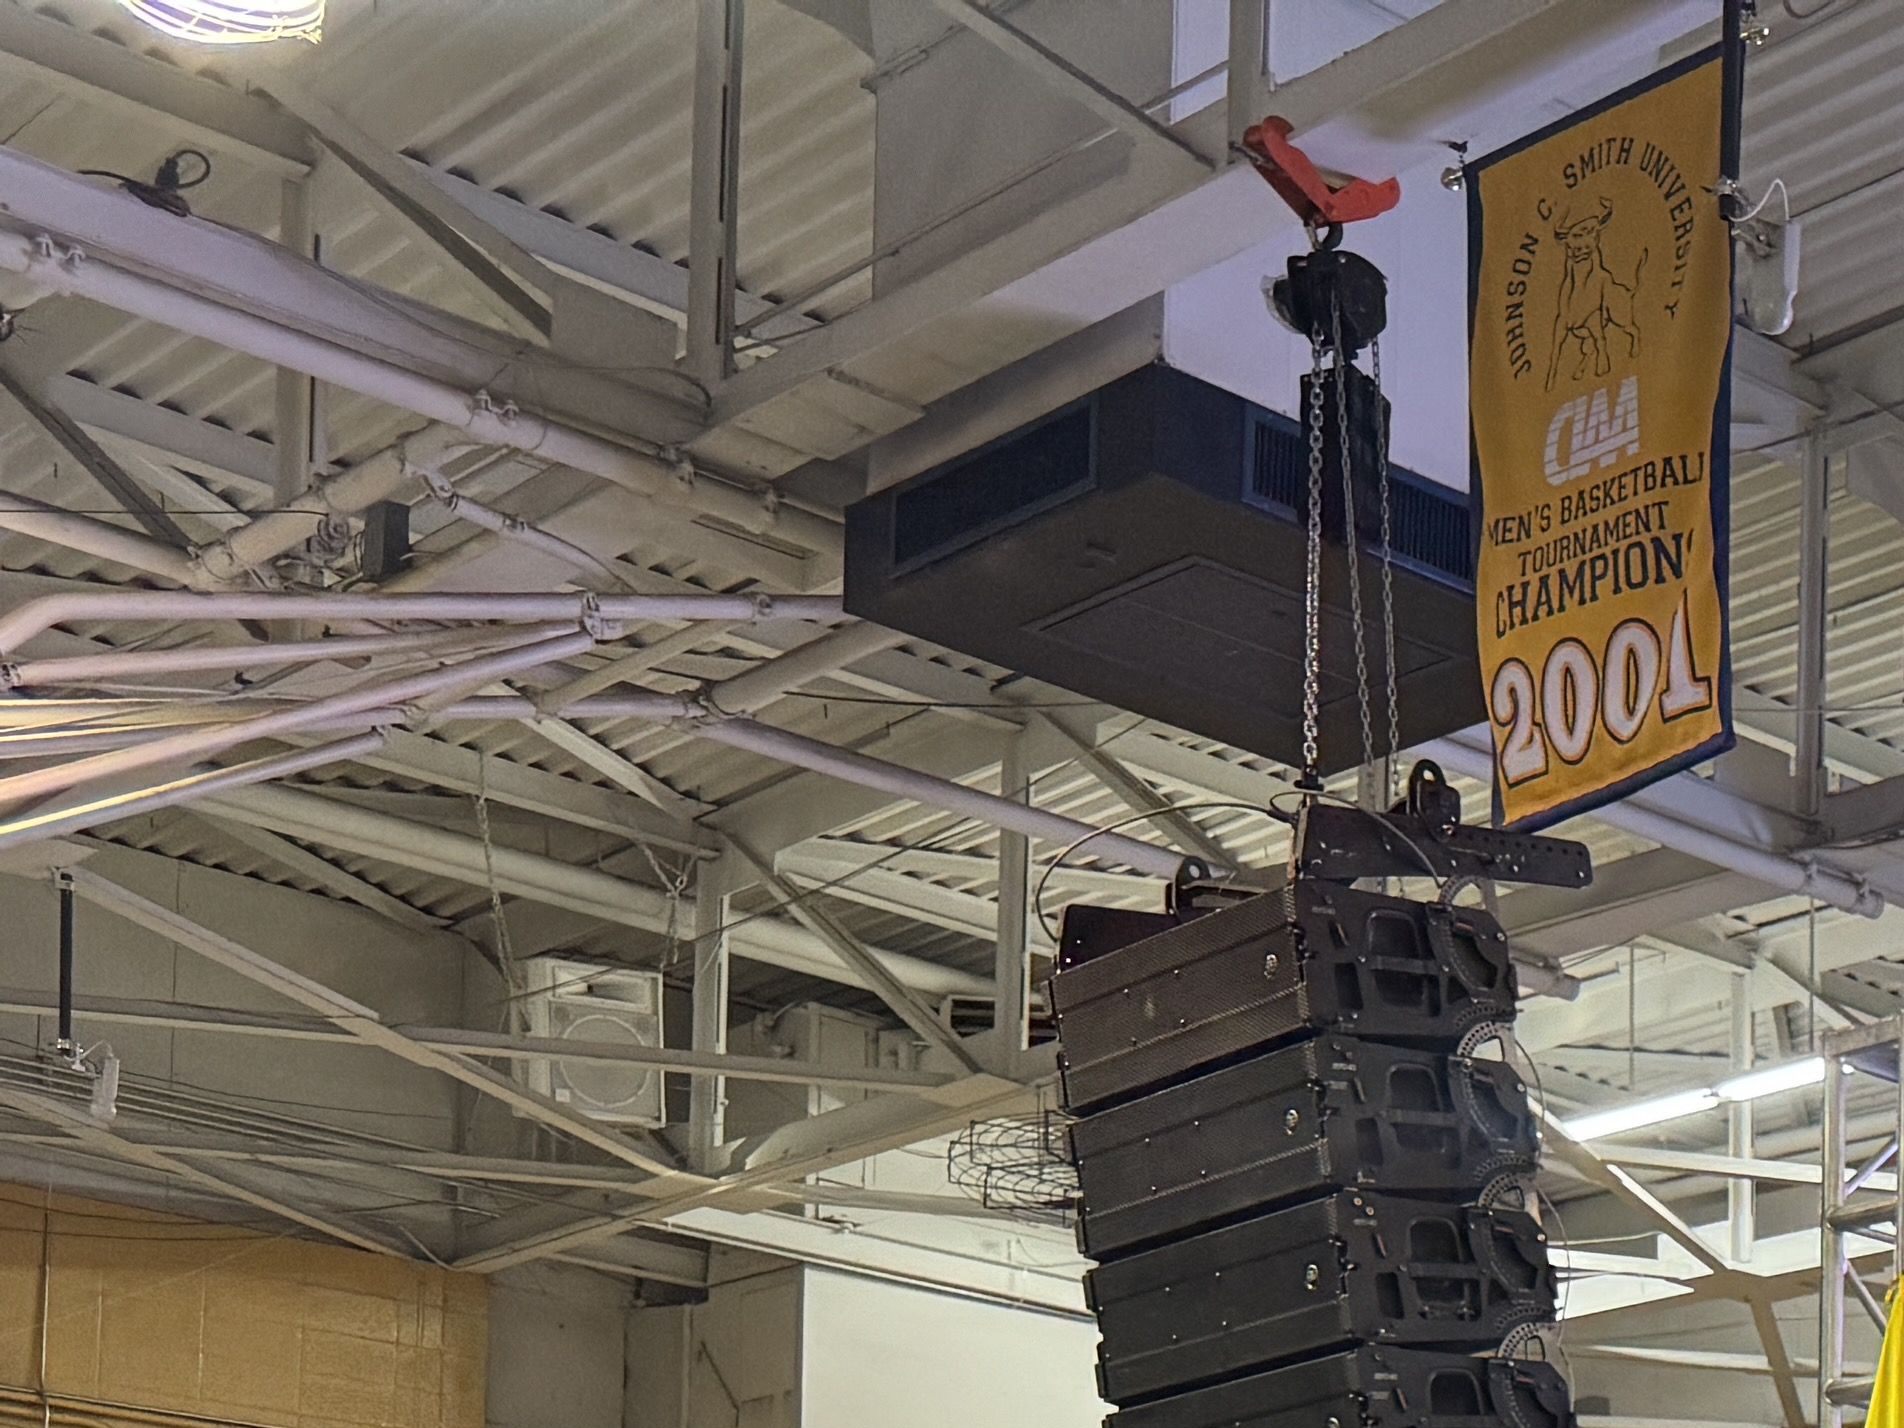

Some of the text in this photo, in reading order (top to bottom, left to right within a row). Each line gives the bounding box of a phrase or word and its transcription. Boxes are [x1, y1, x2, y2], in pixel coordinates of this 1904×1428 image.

[1505, 232, 1540, 380] JOHNSON
[1563, 137, 1634, 190] SMITH
[1640, 141, 1694, 320] UNIVERSITY
[1543, 375, 1641, 487] CIAA
[1495, 528, 1694, 640] CHAMPION
[1518, 500, 1670, 577] TOURNAMENT
[1491, 586, 1713, 789] 2001
